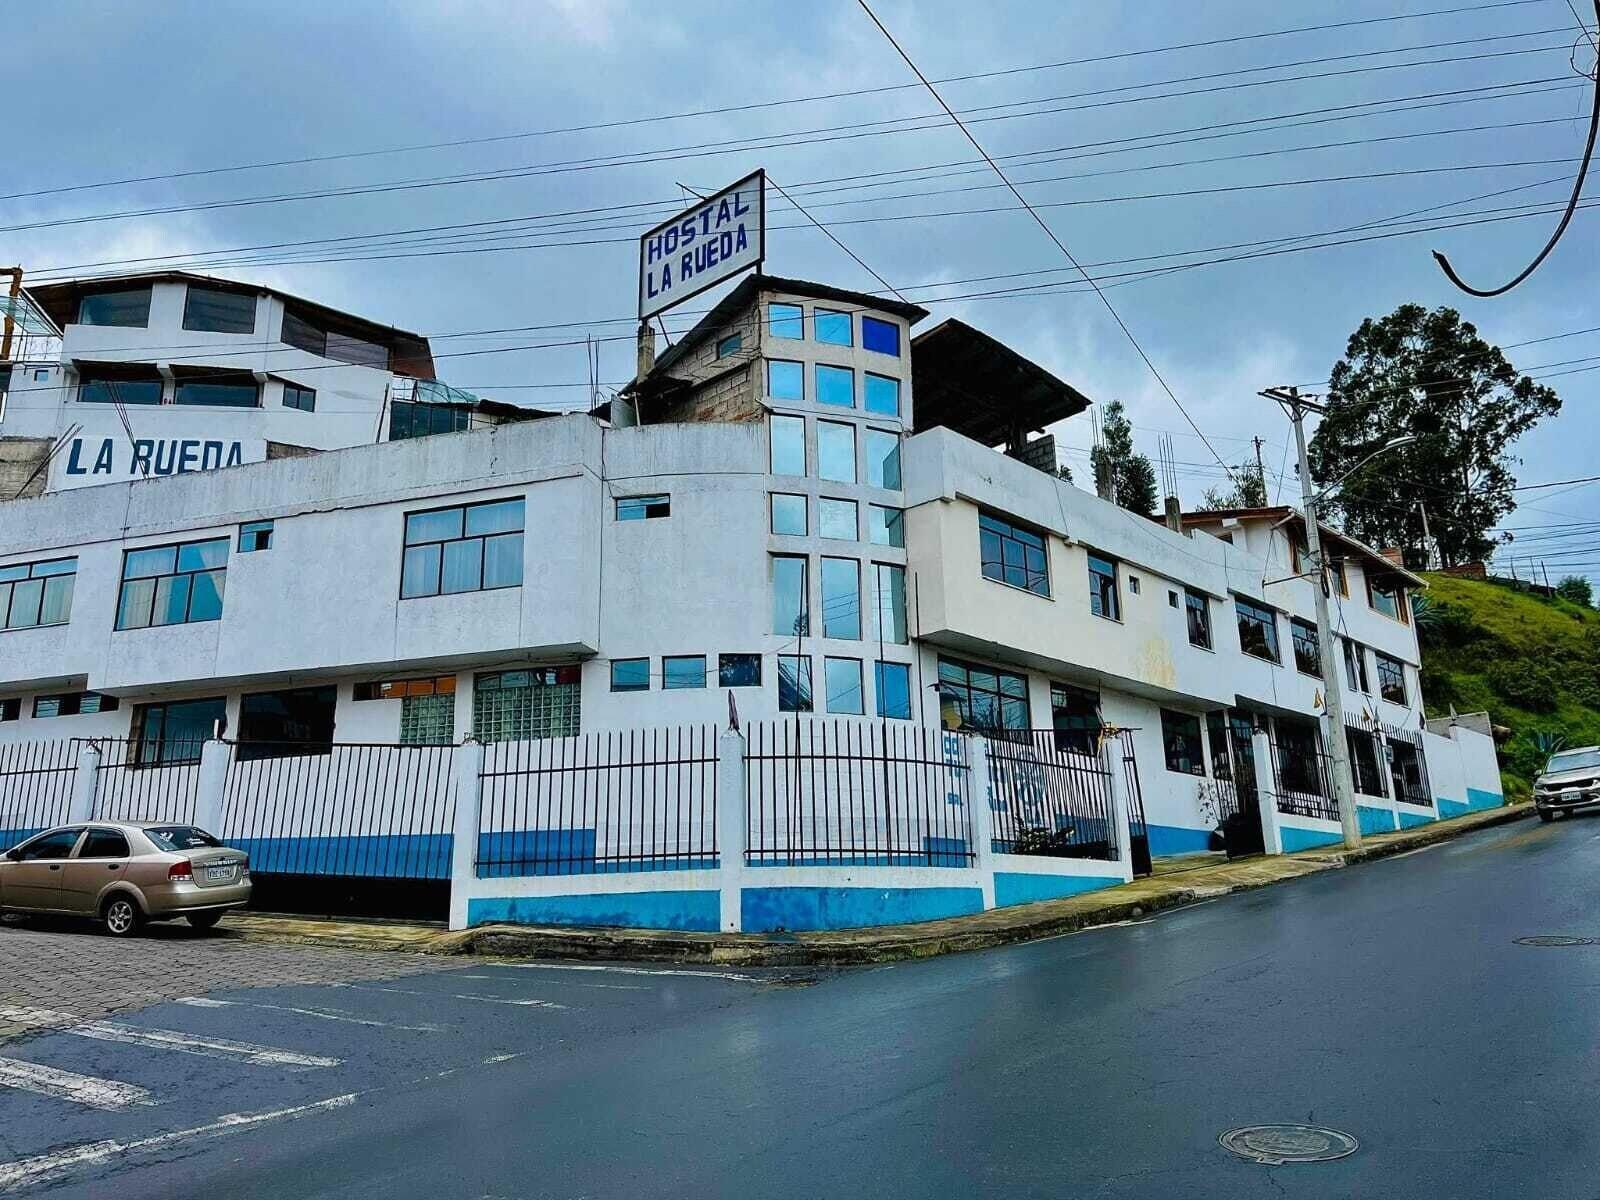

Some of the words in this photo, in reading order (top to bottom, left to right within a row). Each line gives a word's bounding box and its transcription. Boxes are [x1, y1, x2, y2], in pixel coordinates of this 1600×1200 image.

[648, 191, 749, 264] HOSTAL
[648, 263, 672, 299] LA
[681, 223, 747, 281] RUEDA
[67, 438, 113, 474] LA
[130, 439, 241, 474] RUEDA
